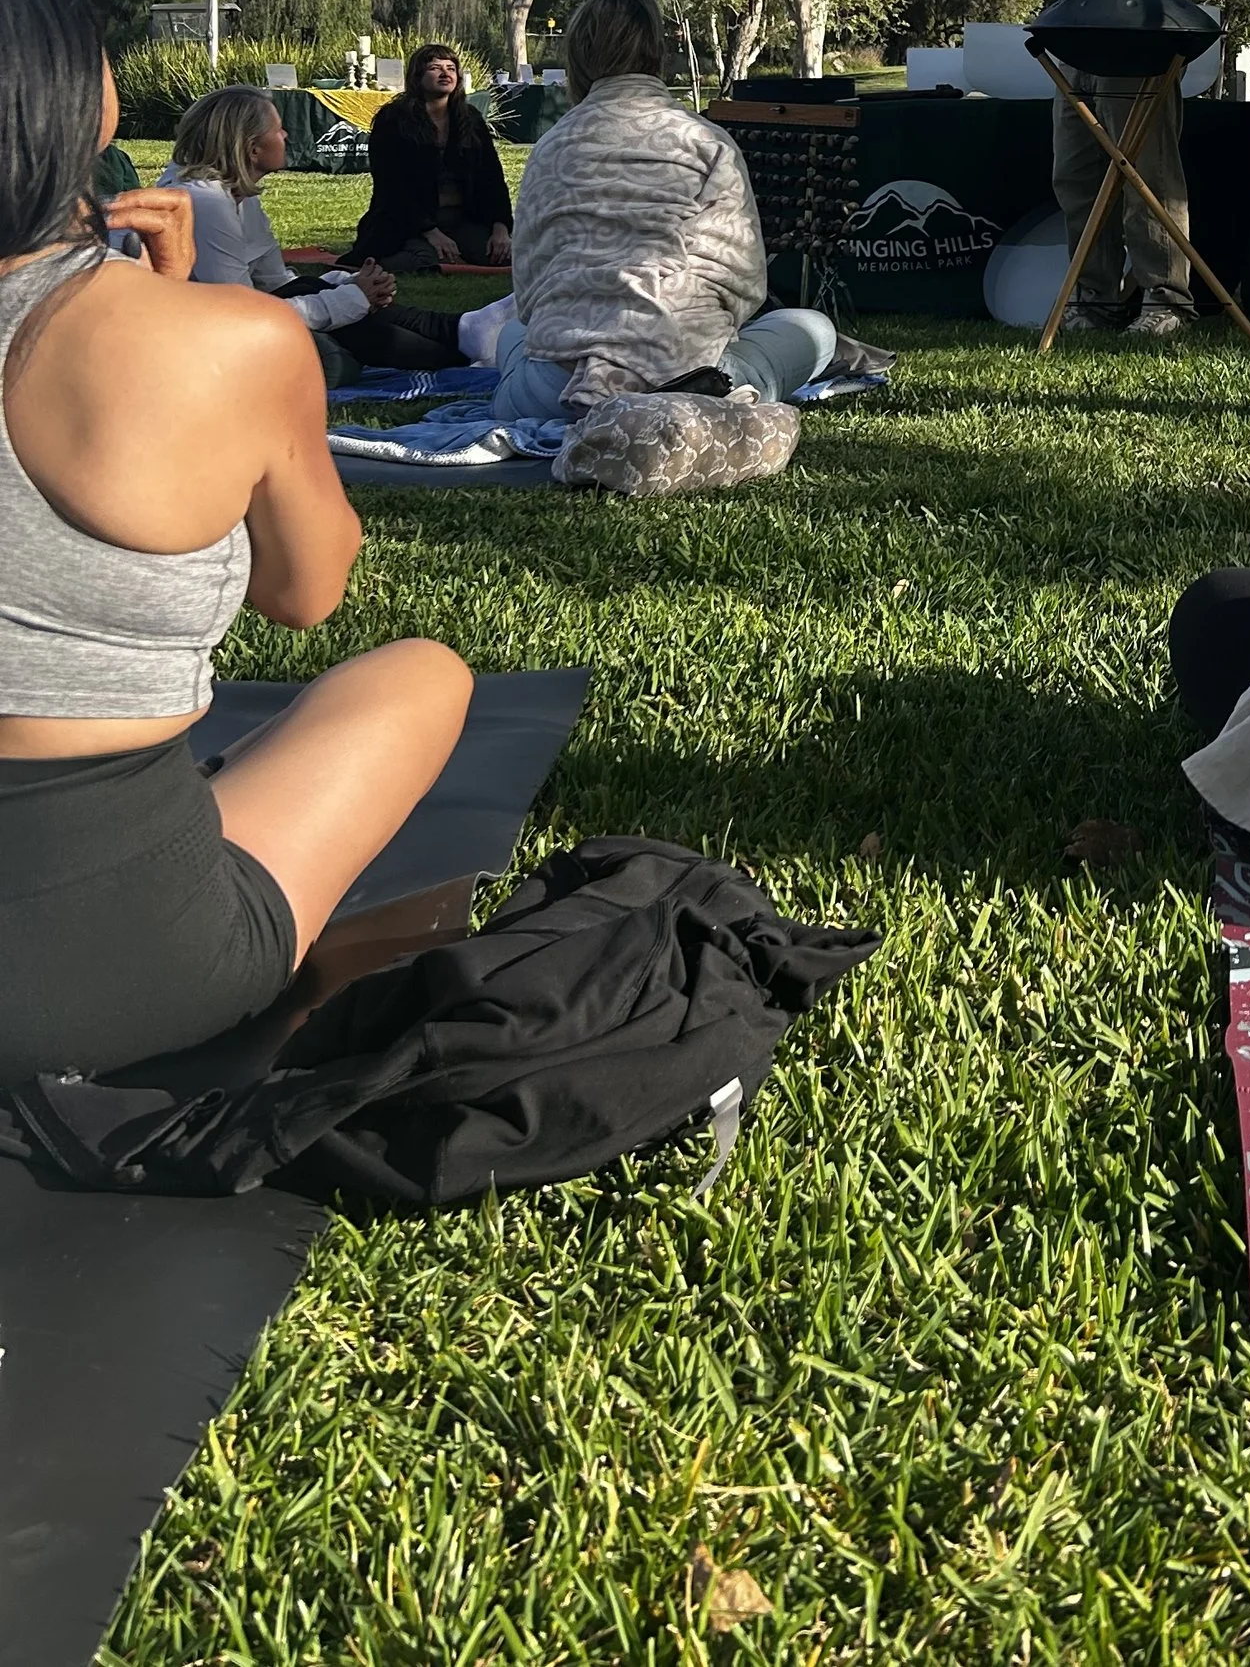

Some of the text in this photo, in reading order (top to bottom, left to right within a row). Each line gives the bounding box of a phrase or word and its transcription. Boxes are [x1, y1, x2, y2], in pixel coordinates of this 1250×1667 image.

[935, 232, 994, 255] HILLS
[857, 255, 973, 273] MEMORIAL PARK
